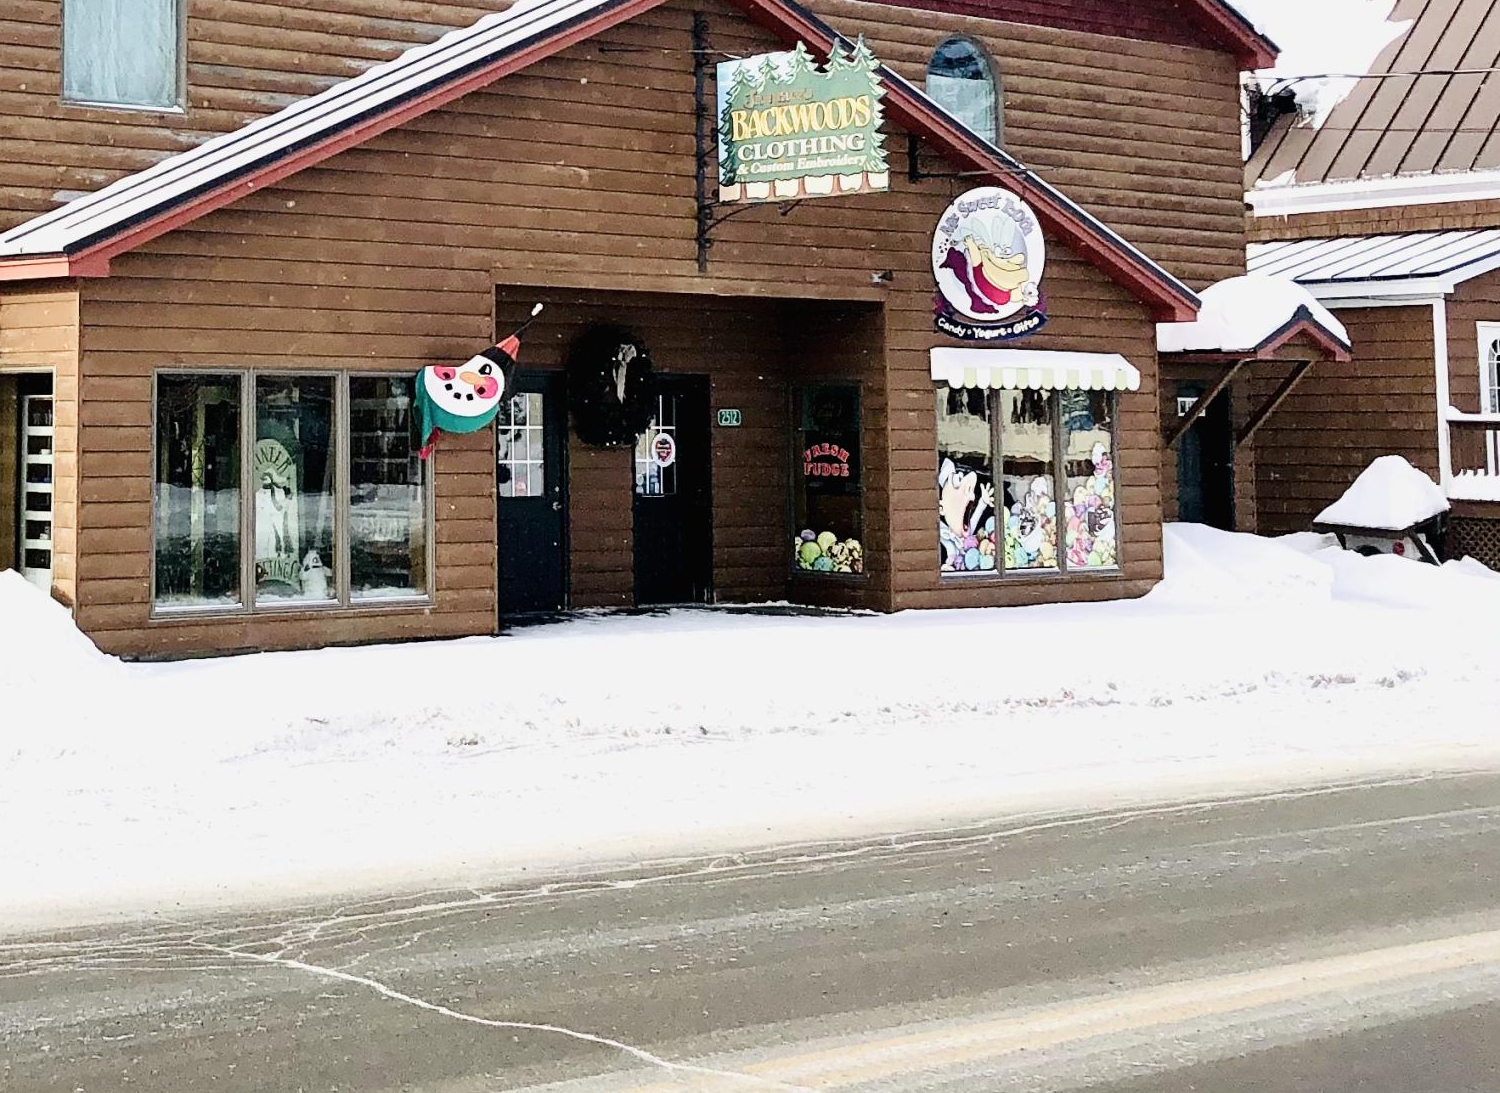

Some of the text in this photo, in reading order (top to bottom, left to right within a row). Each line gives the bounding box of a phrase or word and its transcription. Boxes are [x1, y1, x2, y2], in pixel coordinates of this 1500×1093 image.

[731, 95, 871, 141] BACKWOODS
[737, 133, 865, 161] CLOTHING
[736, 153, 867, 175] & Custom Embroidery
[938, 316, 1040, 339] Candy Yogurt Gifts
[721, 411, 738, 424] 2512
[255, 446, 292, 475] INTER
[803, 442, 850, 463] FRESH
[803, 462, 850, 477] FUDGE
